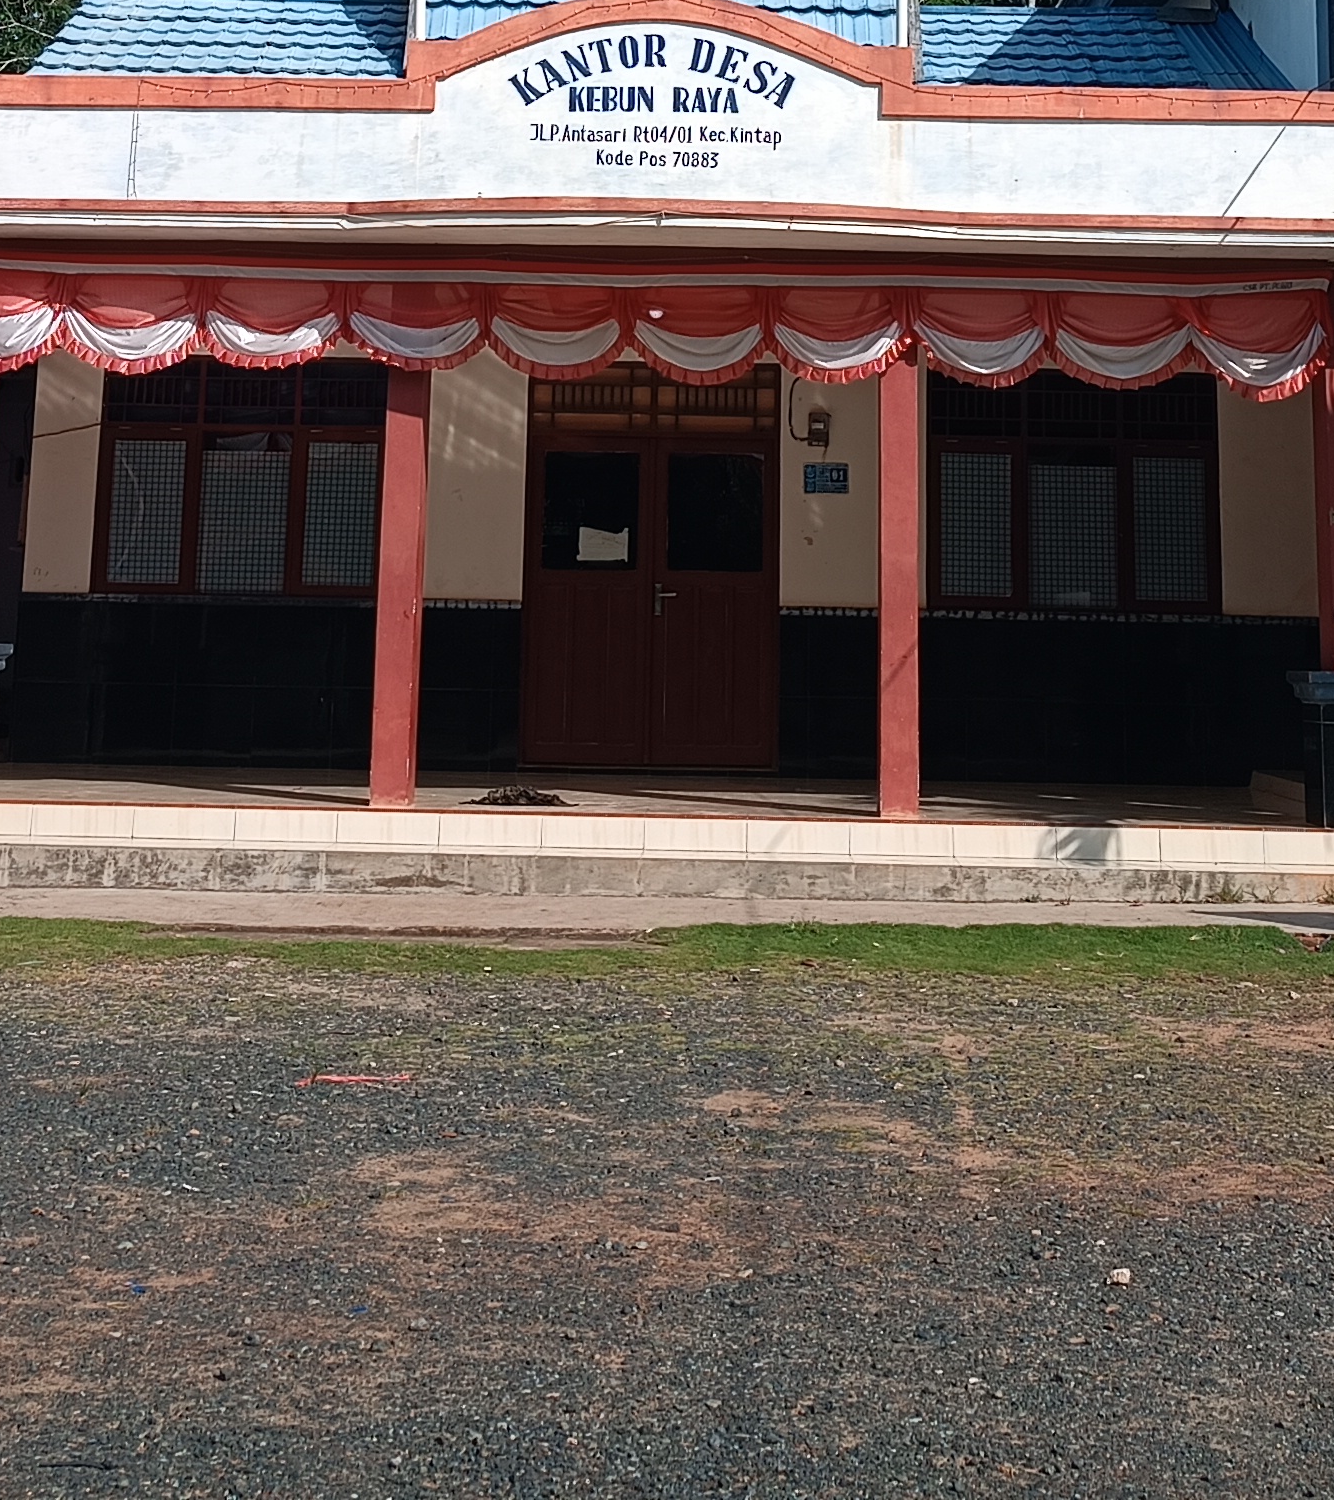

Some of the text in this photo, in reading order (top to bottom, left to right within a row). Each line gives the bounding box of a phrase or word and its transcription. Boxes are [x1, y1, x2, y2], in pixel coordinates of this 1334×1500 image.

[508, 34, 795, 109] KANTOR DESA
[568, 86, 739, 113] KEBUN RAYA
[596, 149, 719, 168] Kode Pos 70883
[831, 469, 844, 481] 01
